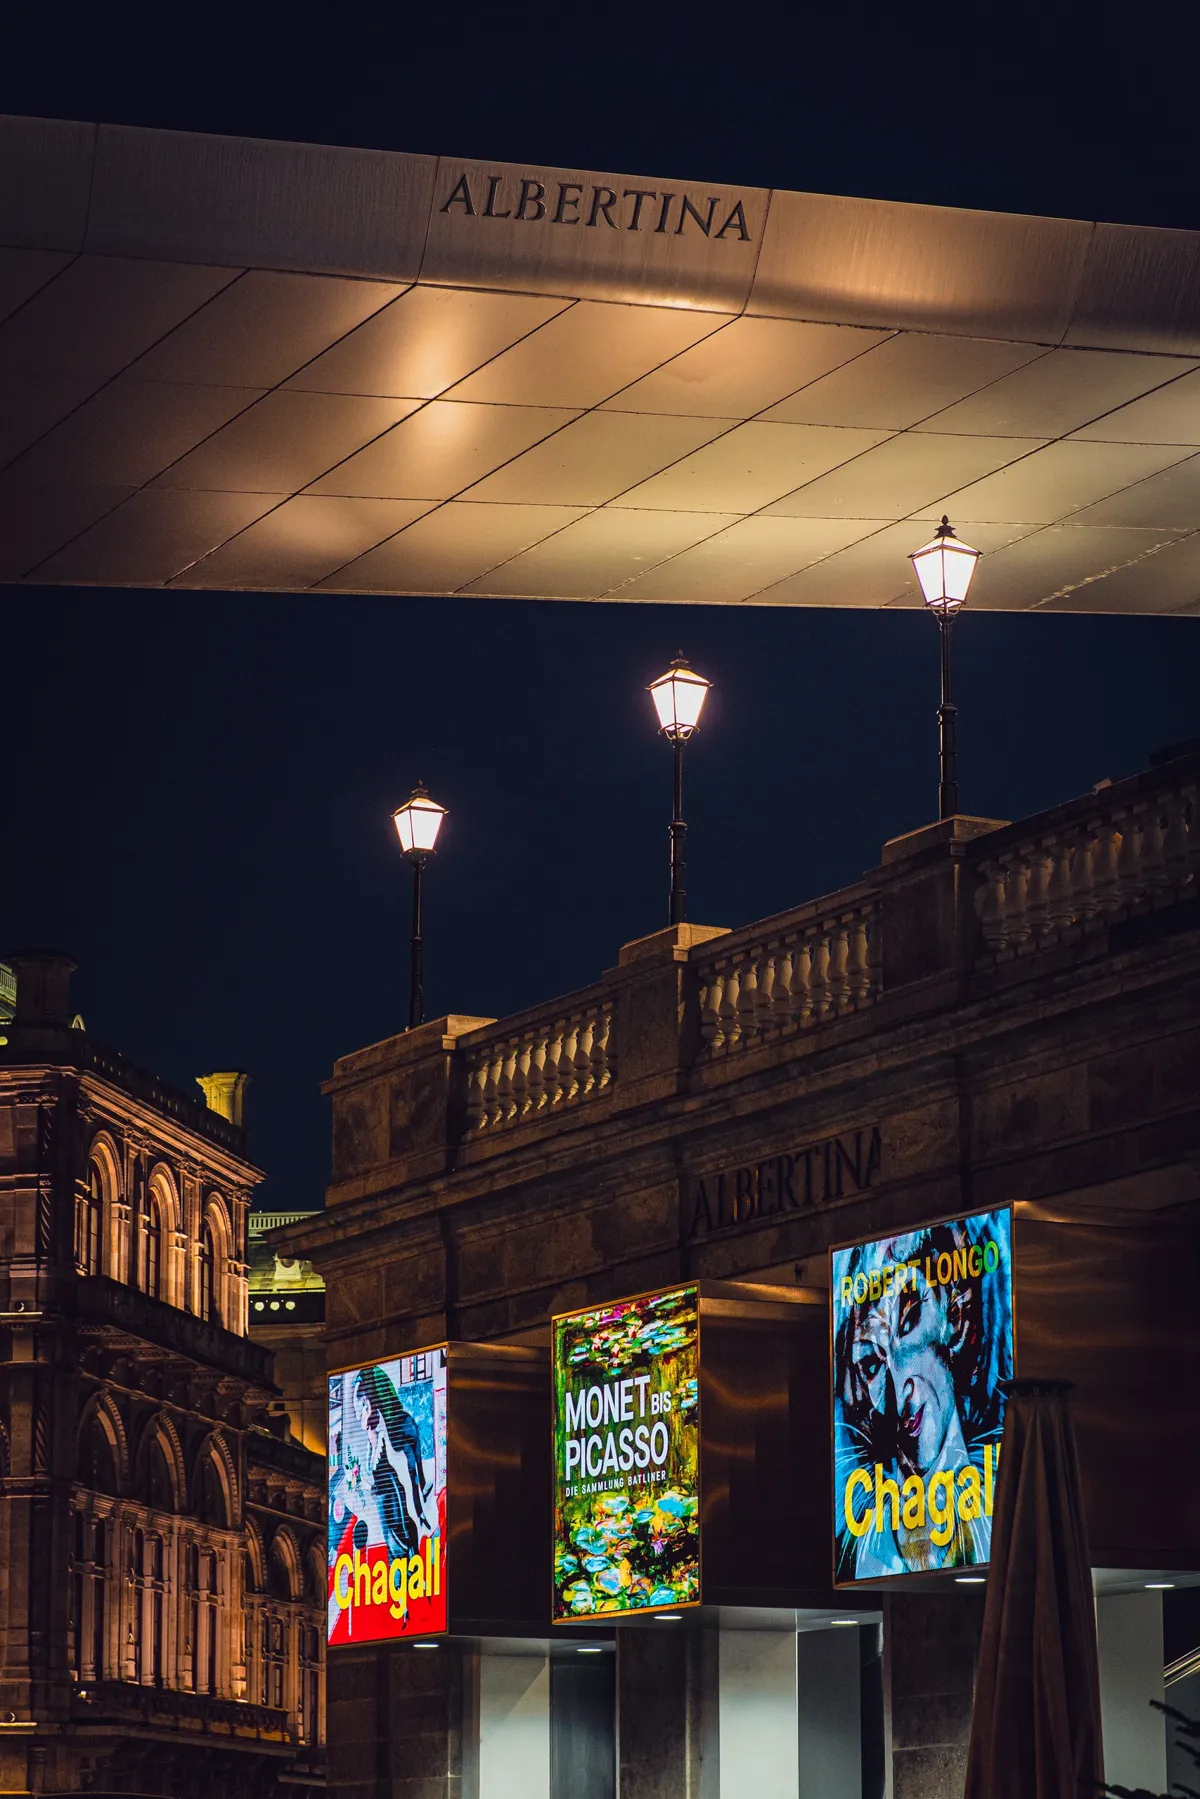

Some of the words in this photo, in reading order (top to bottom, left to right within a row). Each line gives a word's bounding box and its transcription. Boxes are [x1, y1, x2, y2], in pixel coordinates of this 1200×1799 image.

[439, 173, 752, 241] ALBERTINA
[690, 1126, 882, 1239] ALBERTINA
[841, 1259, 920, 1308] ROBERT
[925, 1241, 999, 1288] LONGO
[565, 1374, 650, 1432] MONET
[652, 1390, 672, 1415] BIS
[565, 1421, 669, 1480] PICASSO
[565, 1485, 578, 1497] DIE
[581, 1477, 624, 1494] SAMMLUNG
[628, 1470, 666, 1486] BATLINER
[844, 1443, 1001, 1547] Chagal
[334, 1537, 440, 1619] Chagall
